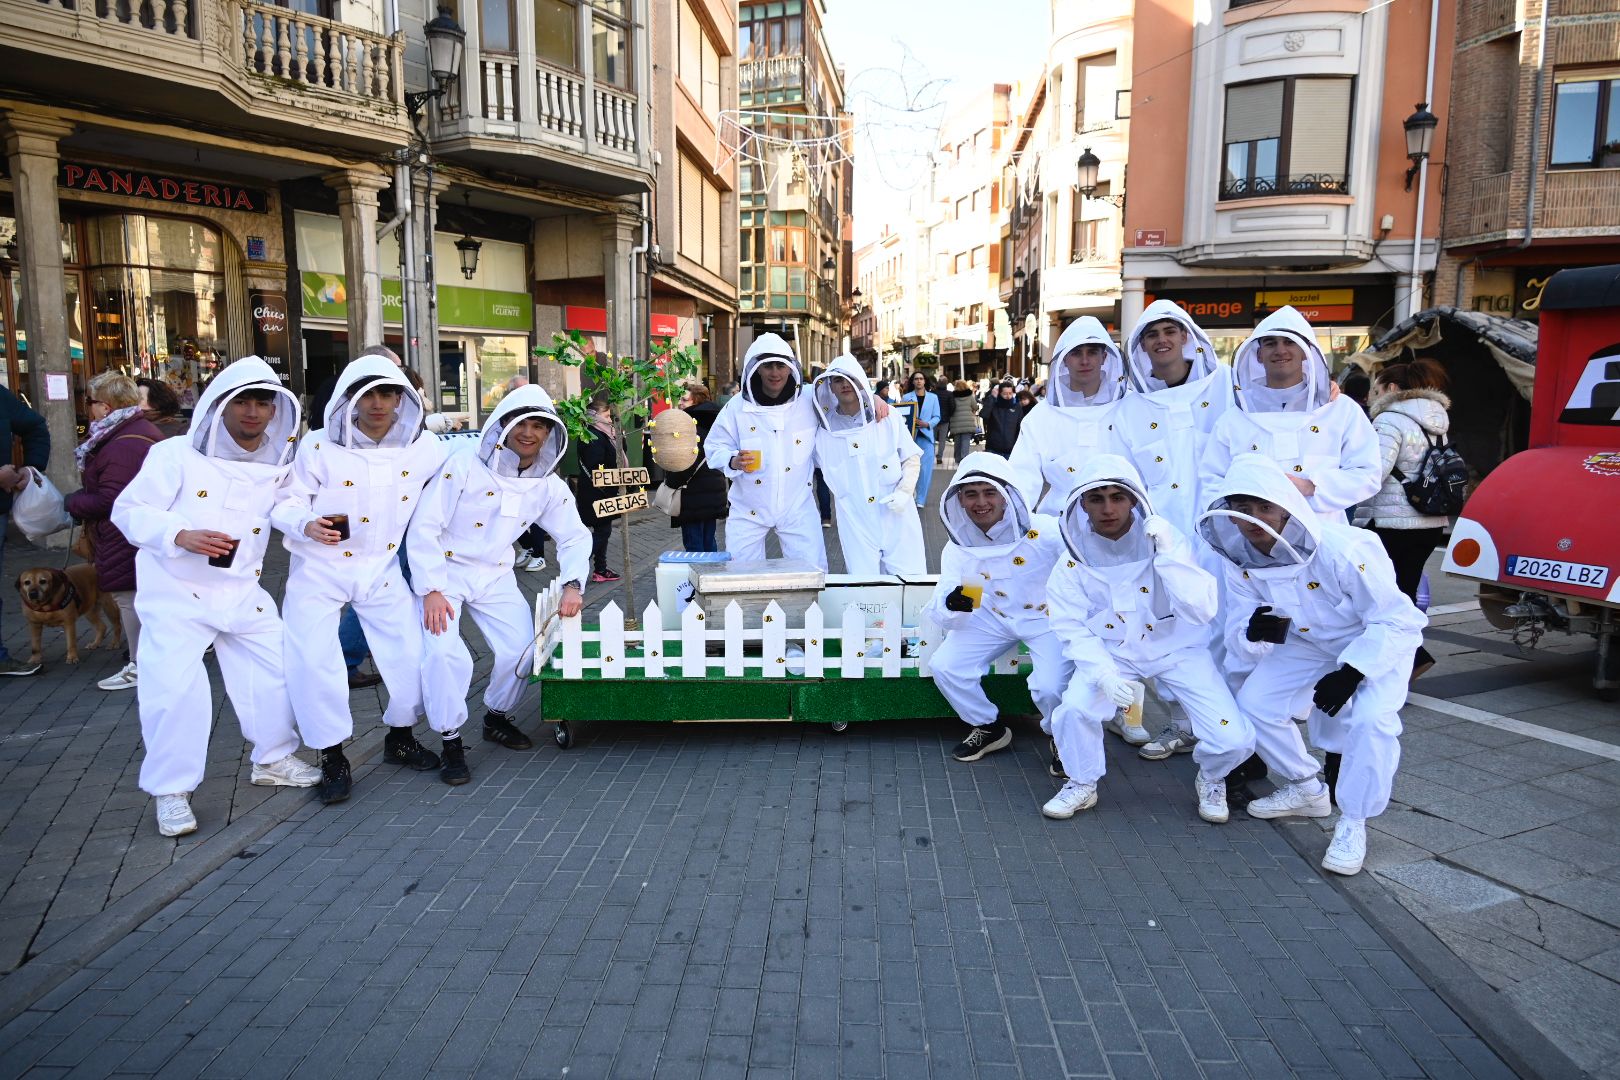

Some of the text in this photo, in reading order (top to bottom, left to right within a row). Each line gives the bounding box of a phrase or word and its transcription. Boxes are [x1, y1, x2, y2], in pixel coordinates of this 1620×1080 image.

[64, 164, 254, 210] PANADERIA
[1288, 293, 1320, 302] Jazztel
[253, 306, 285, 320] Chus
[594, 469, 648, 485] PELIGRO
[598, 493, 647, 515] ABEJAS
[1518, 559, 1562, 579] 2026
[1566, 565, 1604, 585] LBZ
